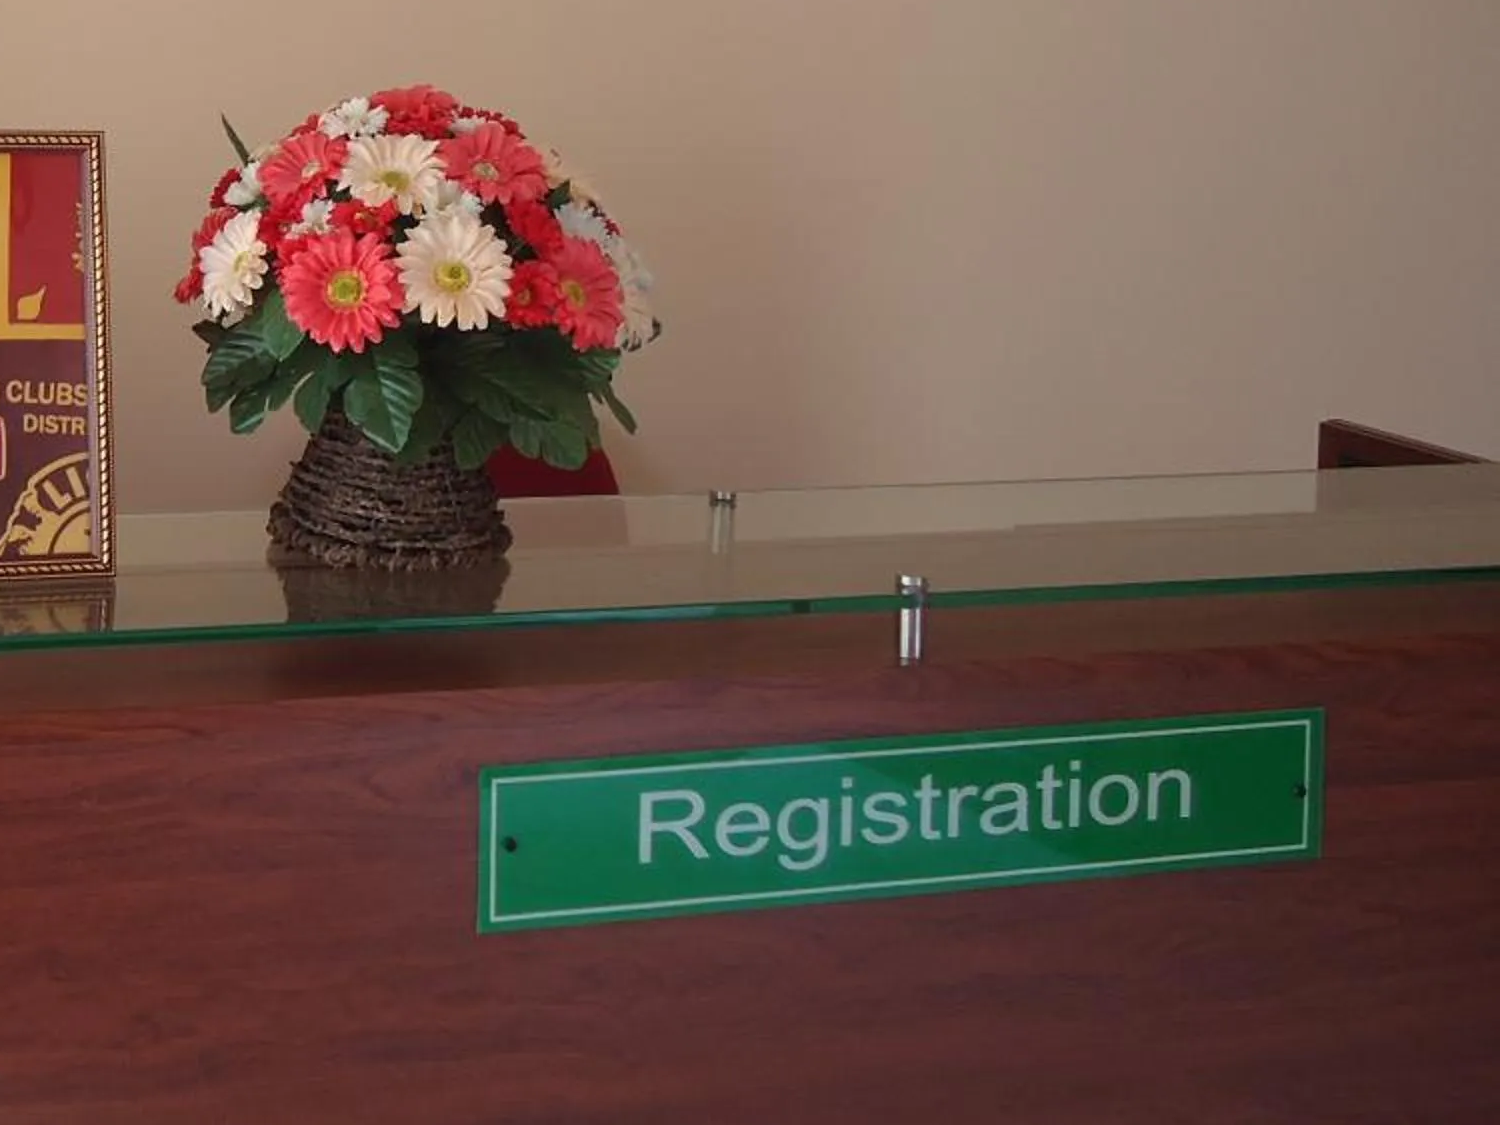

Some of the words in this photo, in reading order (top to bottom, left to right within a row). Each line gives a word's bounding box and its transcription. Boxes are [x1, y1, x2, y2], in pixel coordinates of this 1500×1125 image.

[5, 379, 88, 407] CLUBS
[22, 412, 86, 436] DISTR
[43, 466, 90, 511] LI
[637, 759, 1193, 872] Registration
